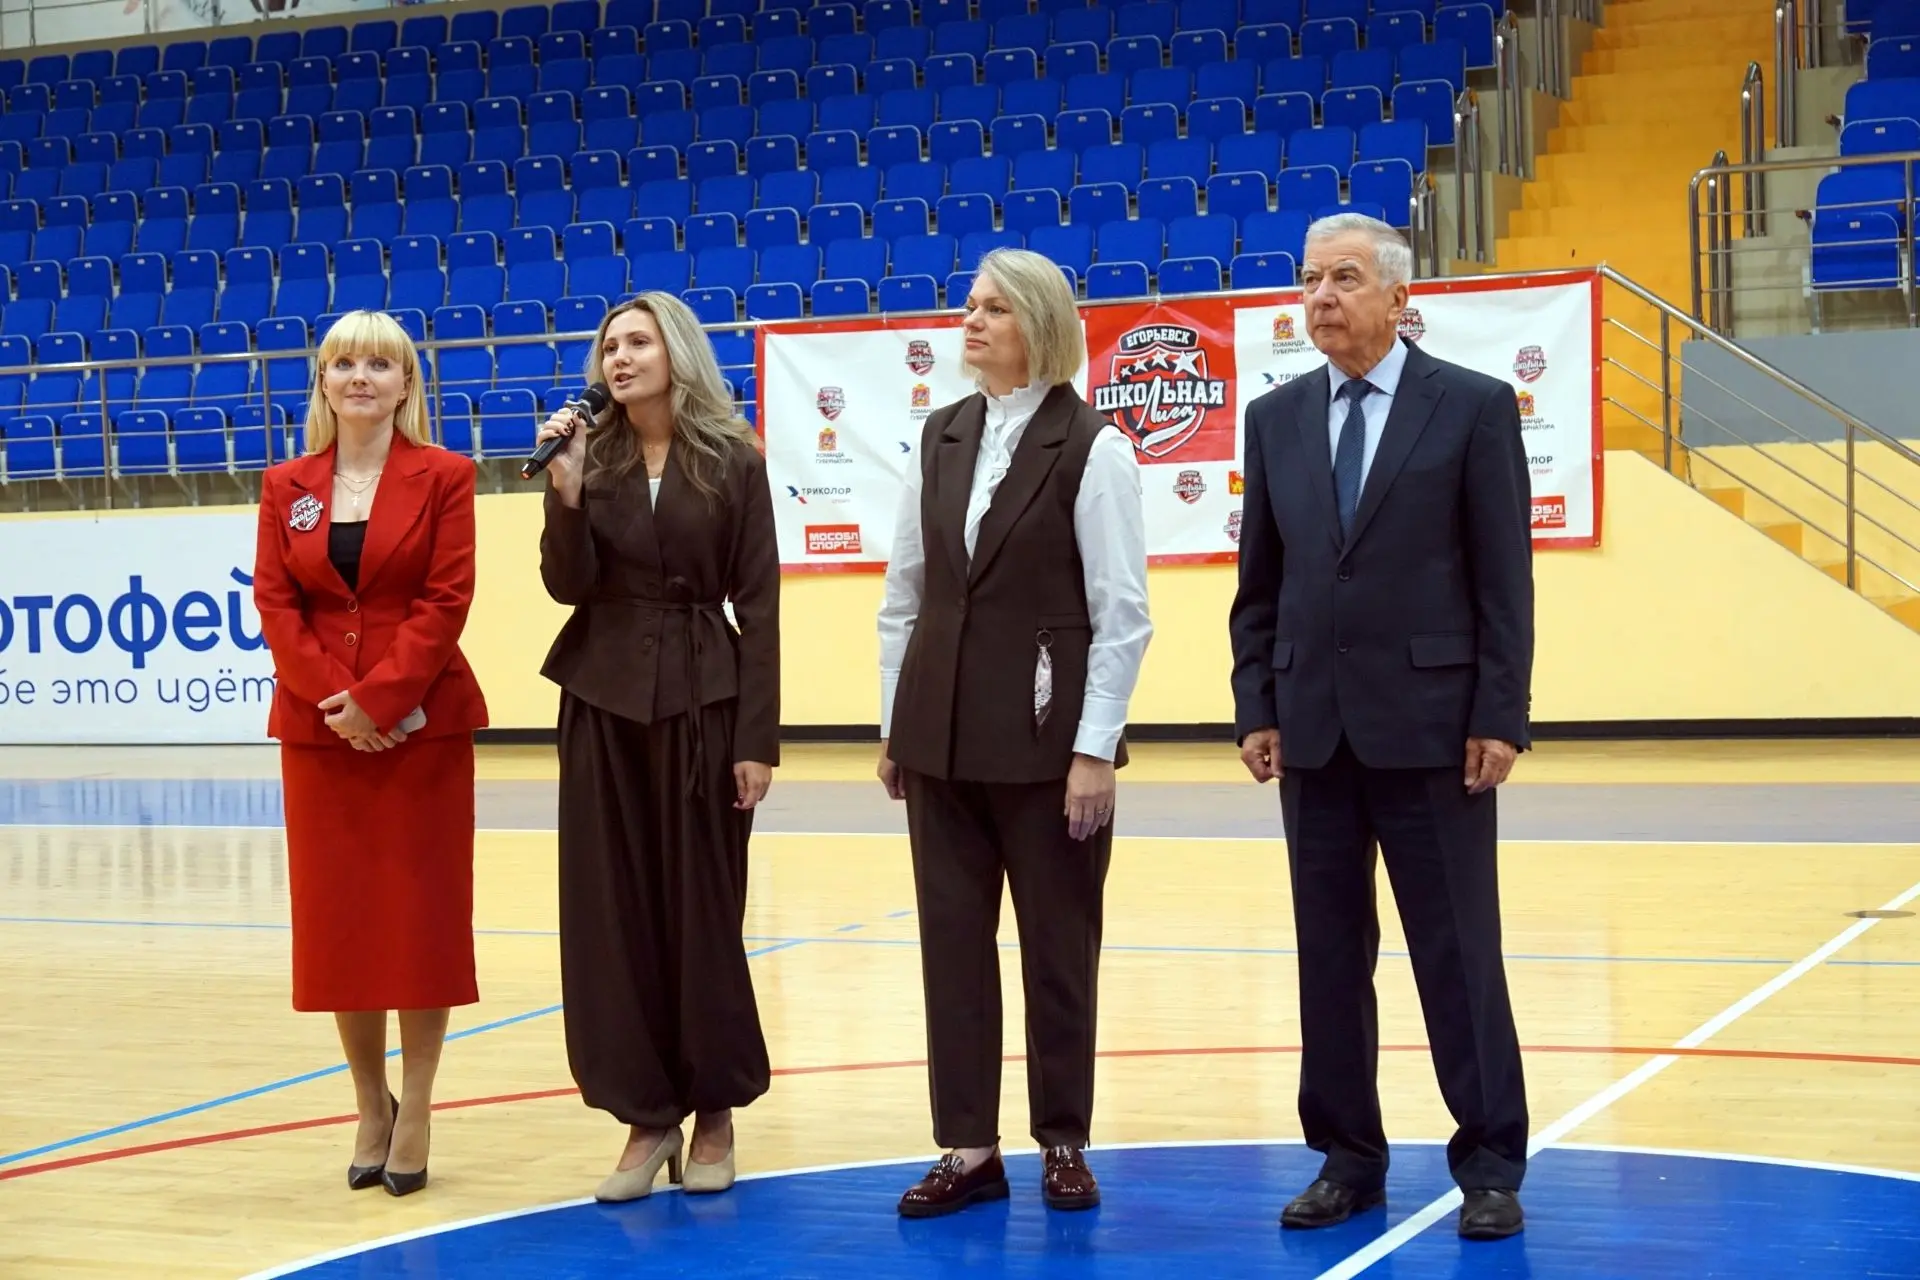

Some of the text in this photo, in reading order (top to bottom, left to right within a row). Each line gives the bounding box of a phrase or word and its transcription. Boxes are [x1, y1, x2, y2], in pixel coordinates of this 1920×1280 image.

[1126, 328, 1191, 348] ЕГОРЬЕВСК
[1272, 346, 1316, 355] ГУБЕРНАТОРА
[1095, 377, 1224, 411] ШКОЛЬНАЯ
[1136, 375, 1198, 430] Лига
[1525, 456, 1553, 464] ЛОР
[801, 487, 852, 495] ТРИКОЛОР
[1531, 504, 1563, 514] ОБЛ
[809, 532, 859, 542] МОСОБЛ
[810, 541, 848, 550] СПОРТ
[0, 566, 271, 669] тофей
[51, 679, 138, 704] это
[157, 668, 276, 713] идёт
